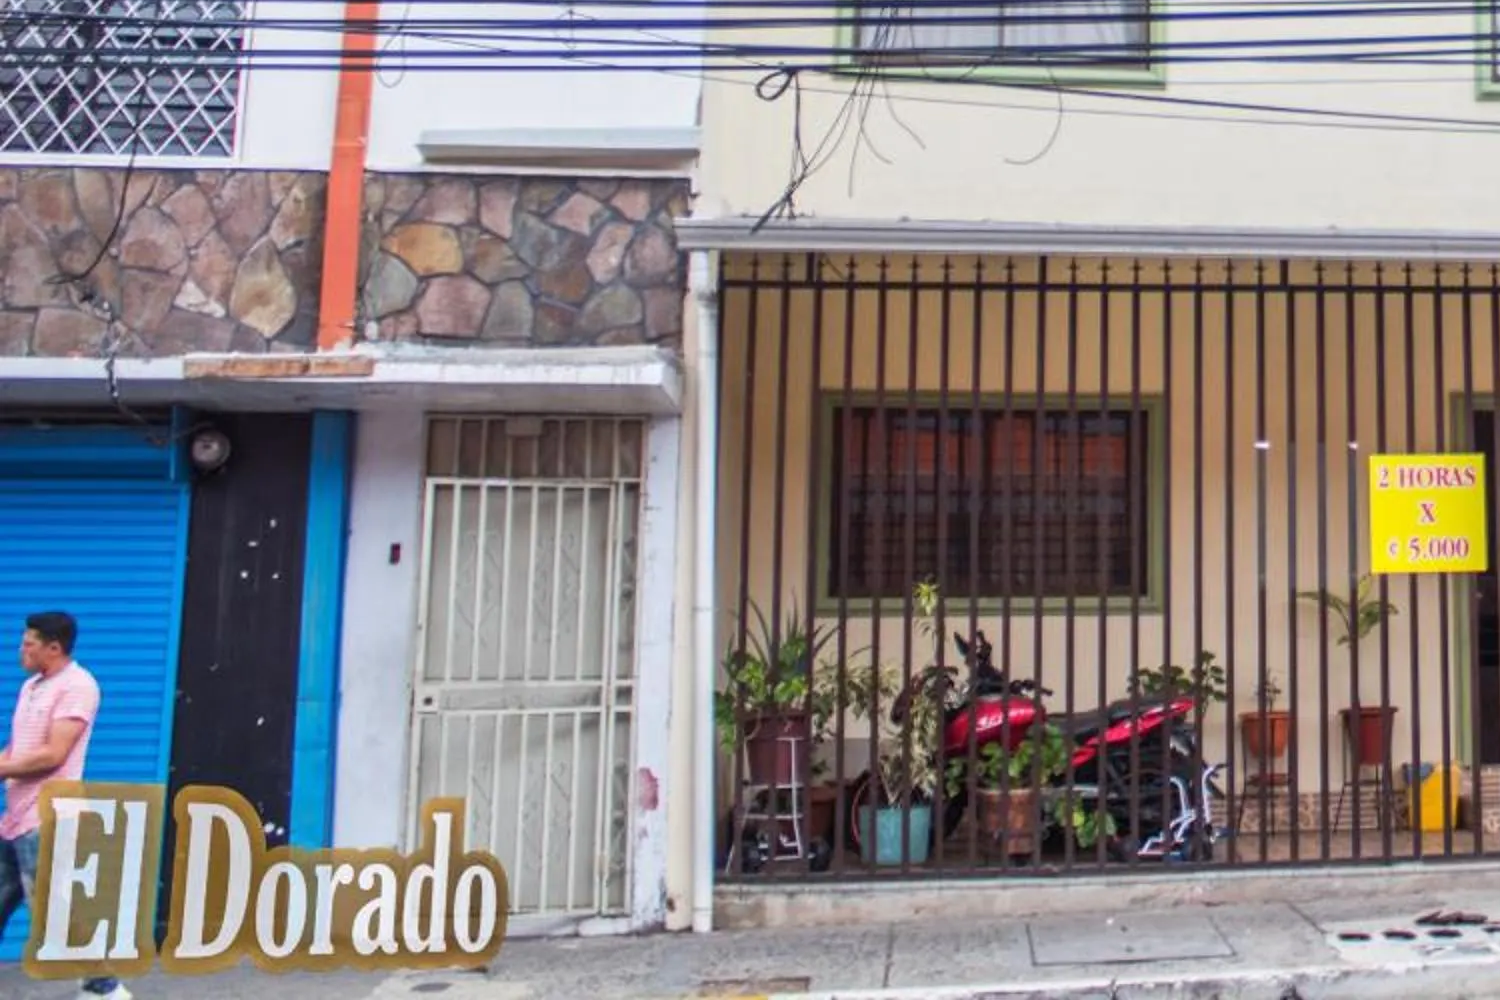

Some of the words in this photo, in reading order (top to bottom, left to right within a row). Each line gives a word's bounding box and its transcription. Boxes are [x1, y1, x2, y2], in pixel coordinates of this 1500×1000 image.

[1379, 466, 1389, 488] 2
[1398, 466, 1476, 488] HORAS
[1420, 502, 1436, 523] X
[1409, 537, 1470, 560] 5.000
